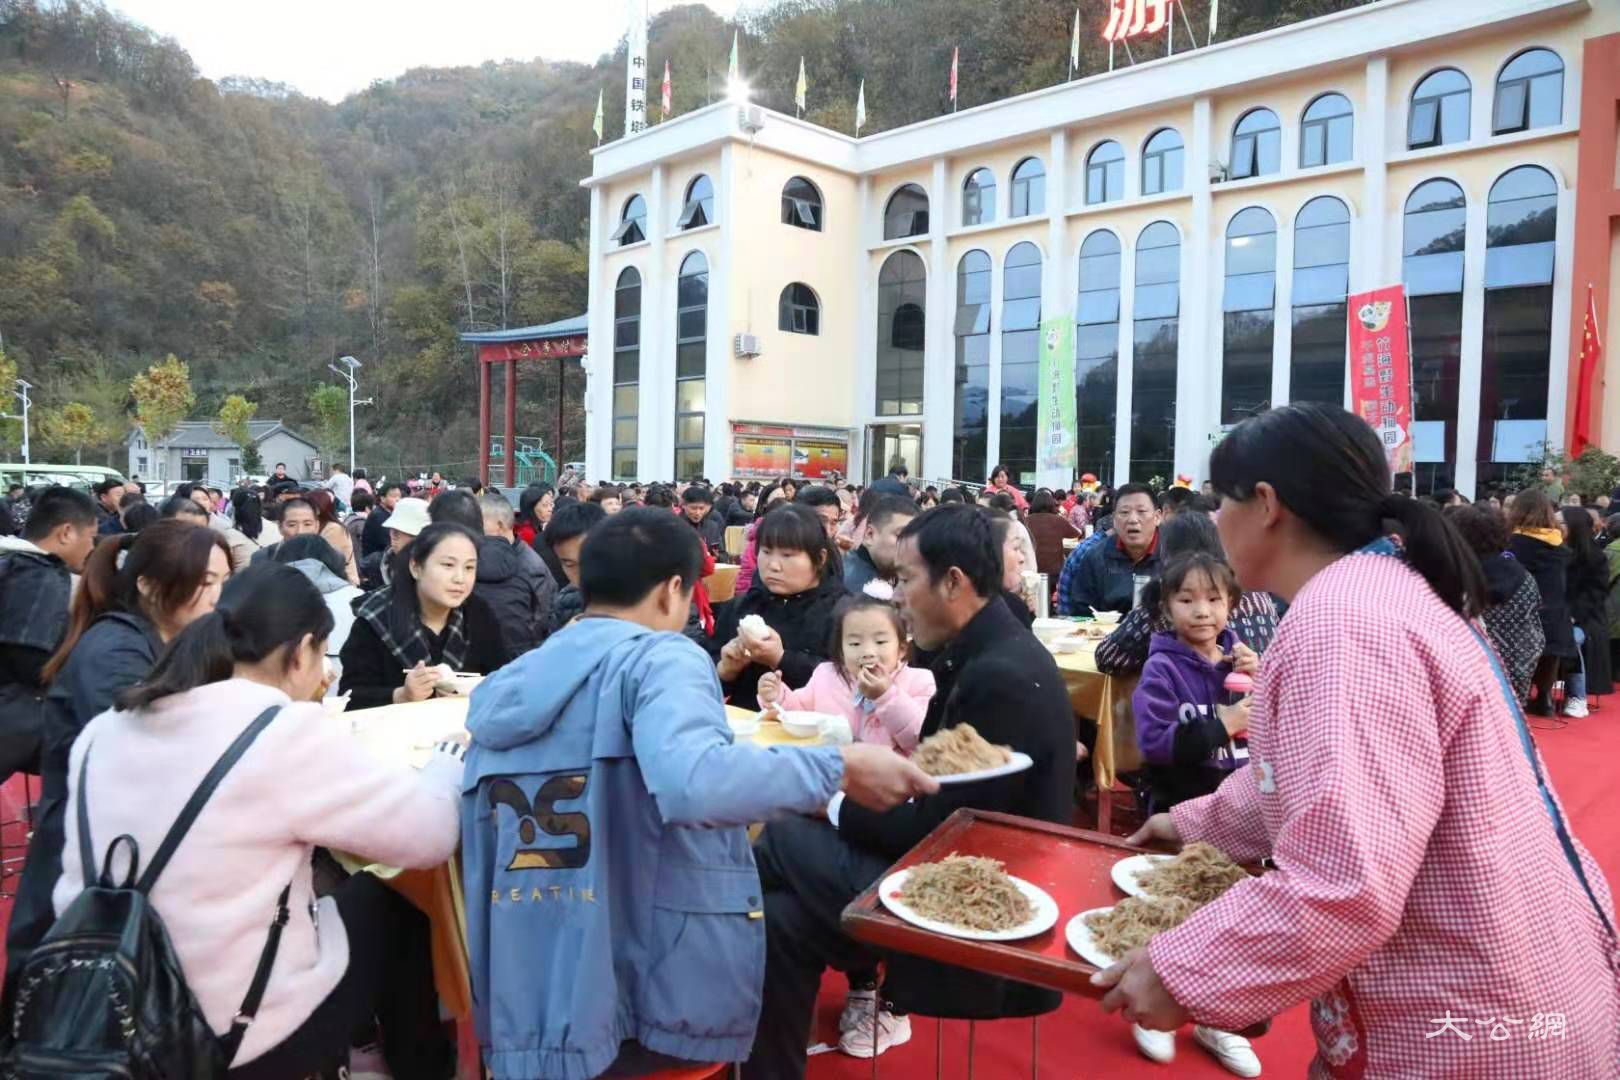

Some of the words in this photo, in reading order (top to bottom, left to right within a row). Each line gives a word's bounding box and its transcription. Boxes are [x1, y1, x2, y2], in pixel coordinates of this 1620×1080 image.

[1376, 336, 1398, 445] 竹海野生动物园
